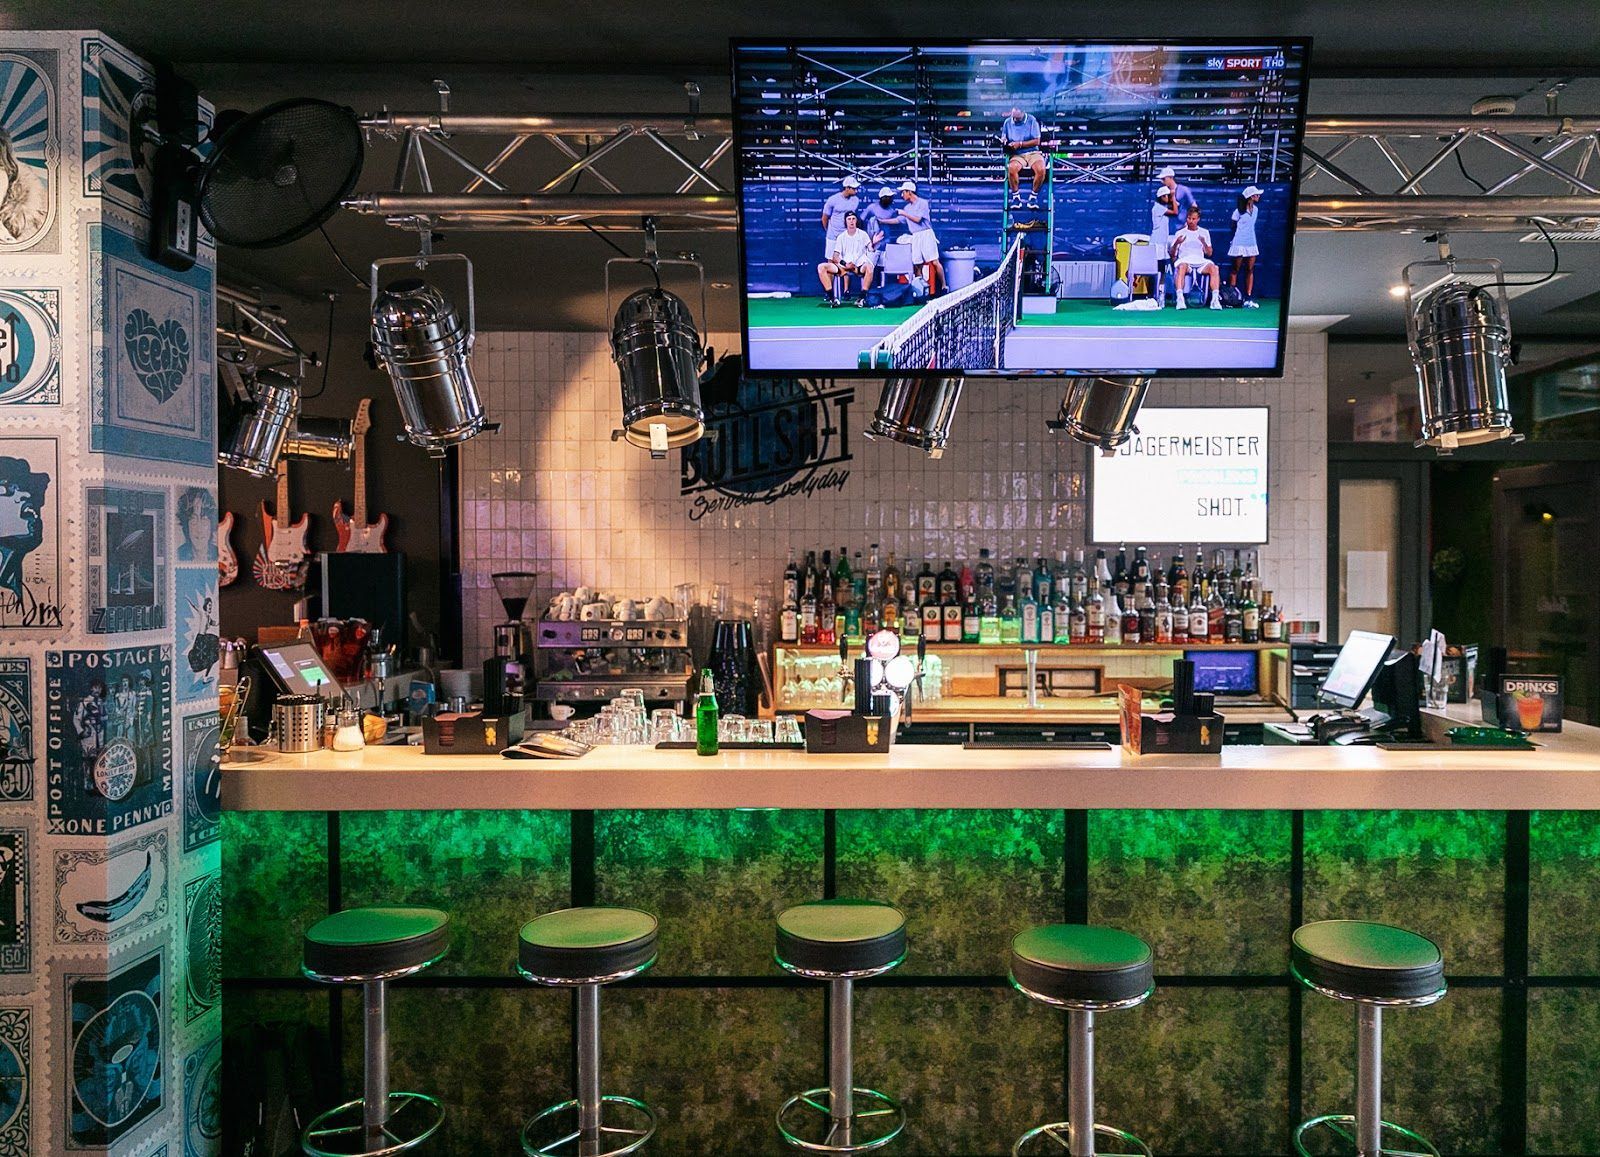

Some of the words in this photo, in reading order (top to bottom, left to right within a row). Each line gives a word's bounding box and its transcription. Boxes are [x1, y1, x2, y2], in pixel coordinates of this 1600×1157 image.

[1207, 57, 1224, 69] sky
[1226, 58, 1262, 68] SPORT
[93, 604, 166, 634] ZEPPELIN
[1505, 681, 1557, 693] DRINKS
[49, 677, 62, 750] OFFICE
[161, 665, 173, 792] MAURITIUS
[2, 763, 28, 794] 50
[50, 758, 62, 815] POST
[66, 818, 107, 834] ONE
[113, 800, 164, 831] PENNY
[5, 949, 21, 963] 50
